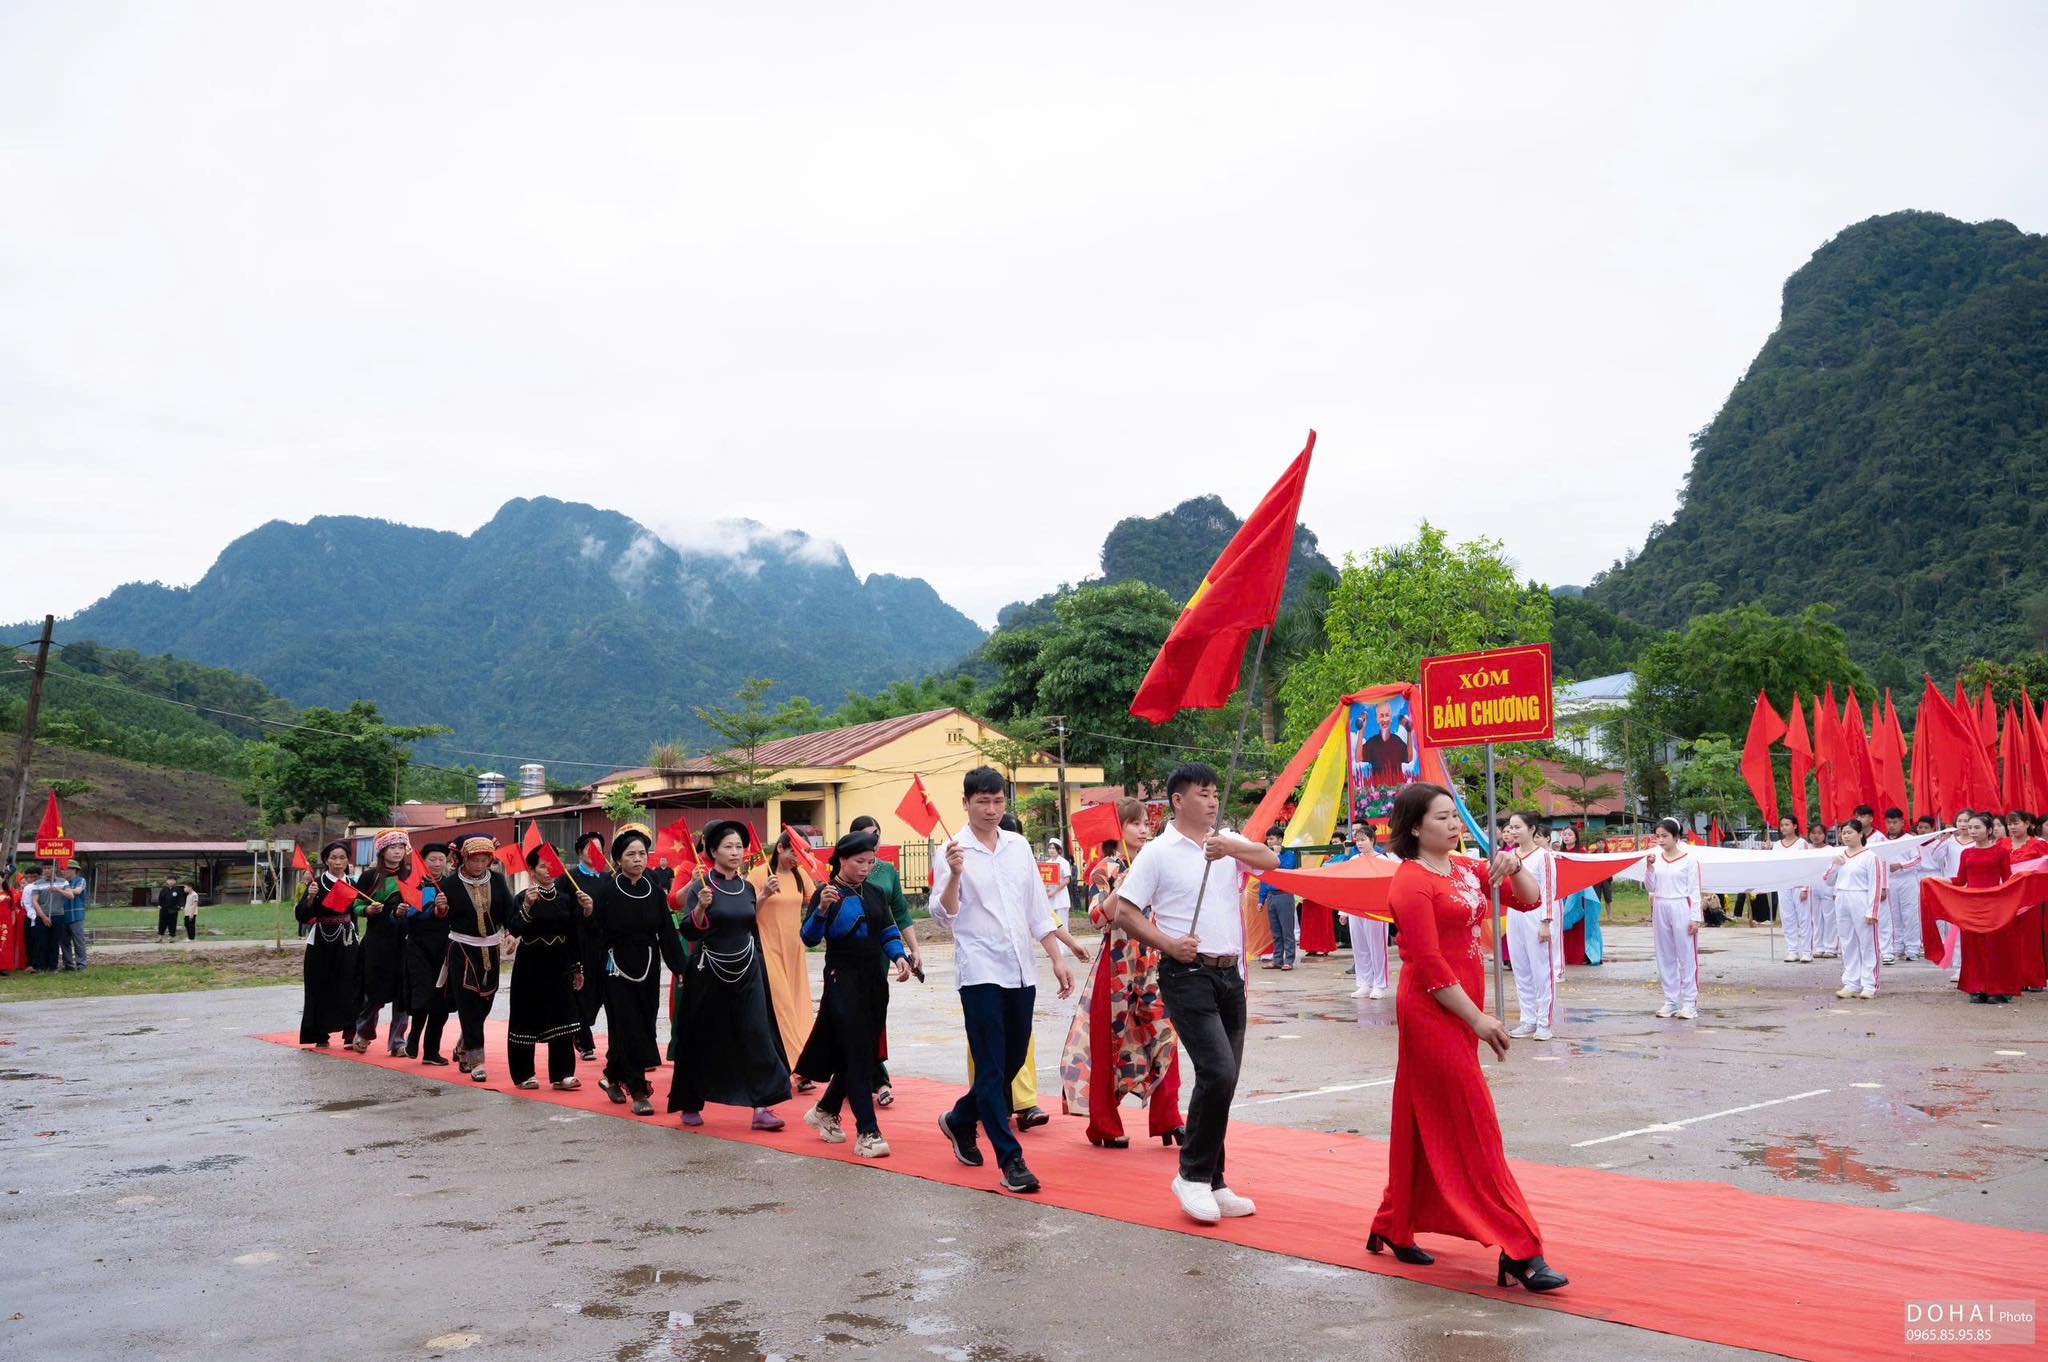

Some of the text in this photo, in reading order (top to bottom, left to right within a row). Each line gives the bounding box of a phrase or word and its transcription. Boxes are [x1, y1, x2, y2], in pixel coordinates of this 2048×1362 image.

[1458, 667, 1510, 689] XÓM
[1433, 695, 1540, 729] BẢN CHƯƠNG
